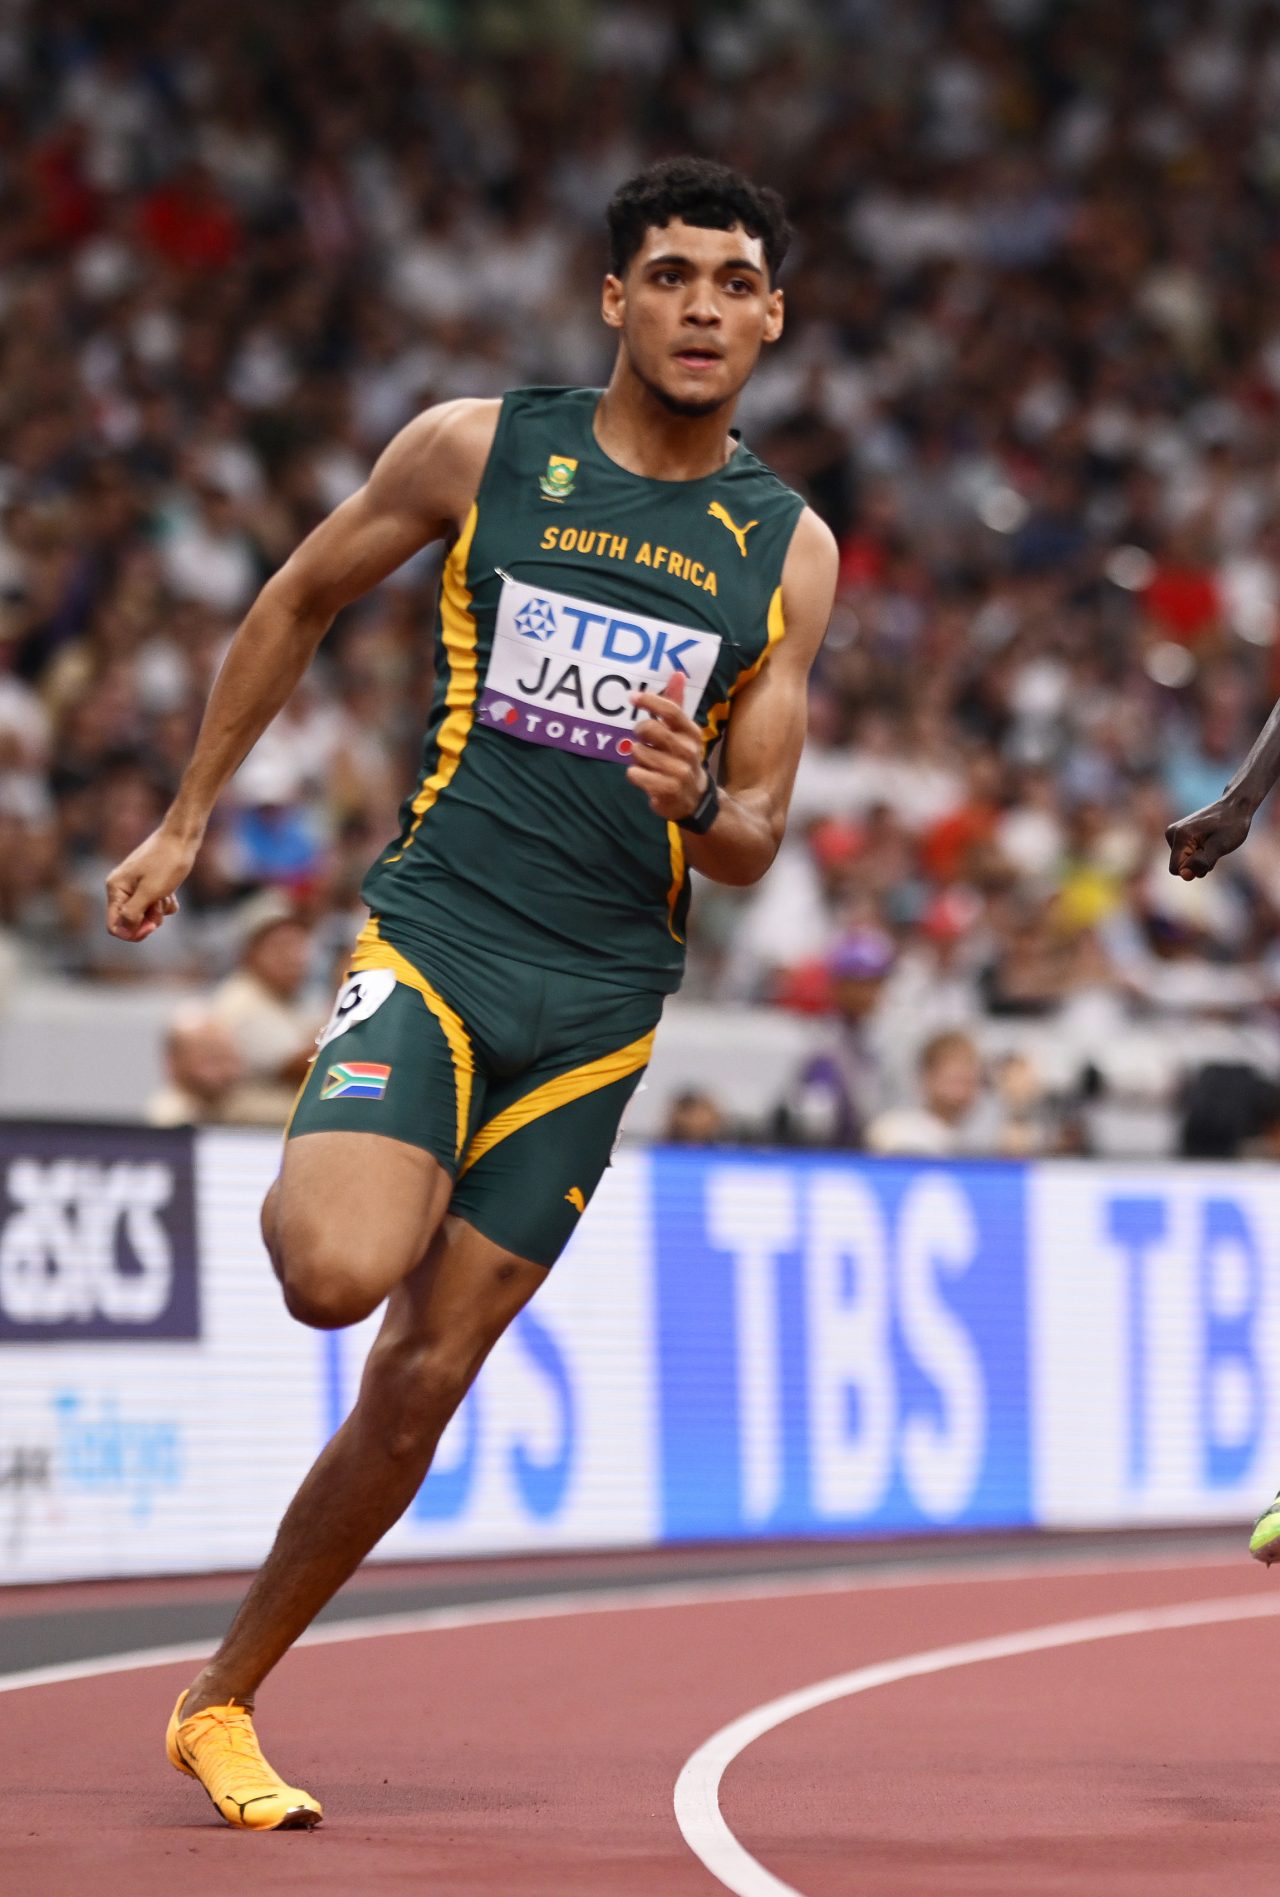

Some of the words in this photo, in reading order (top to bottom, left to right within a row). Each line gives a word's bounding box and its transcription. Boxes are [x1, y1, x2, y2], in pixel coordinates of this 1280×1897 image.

[540, 526, 629, 561] SOUTH
[634, 541, 718, 597] AFRICA
[562, 606, 702, 679] TDK
[703, 1162, 992, 1530] TBS
